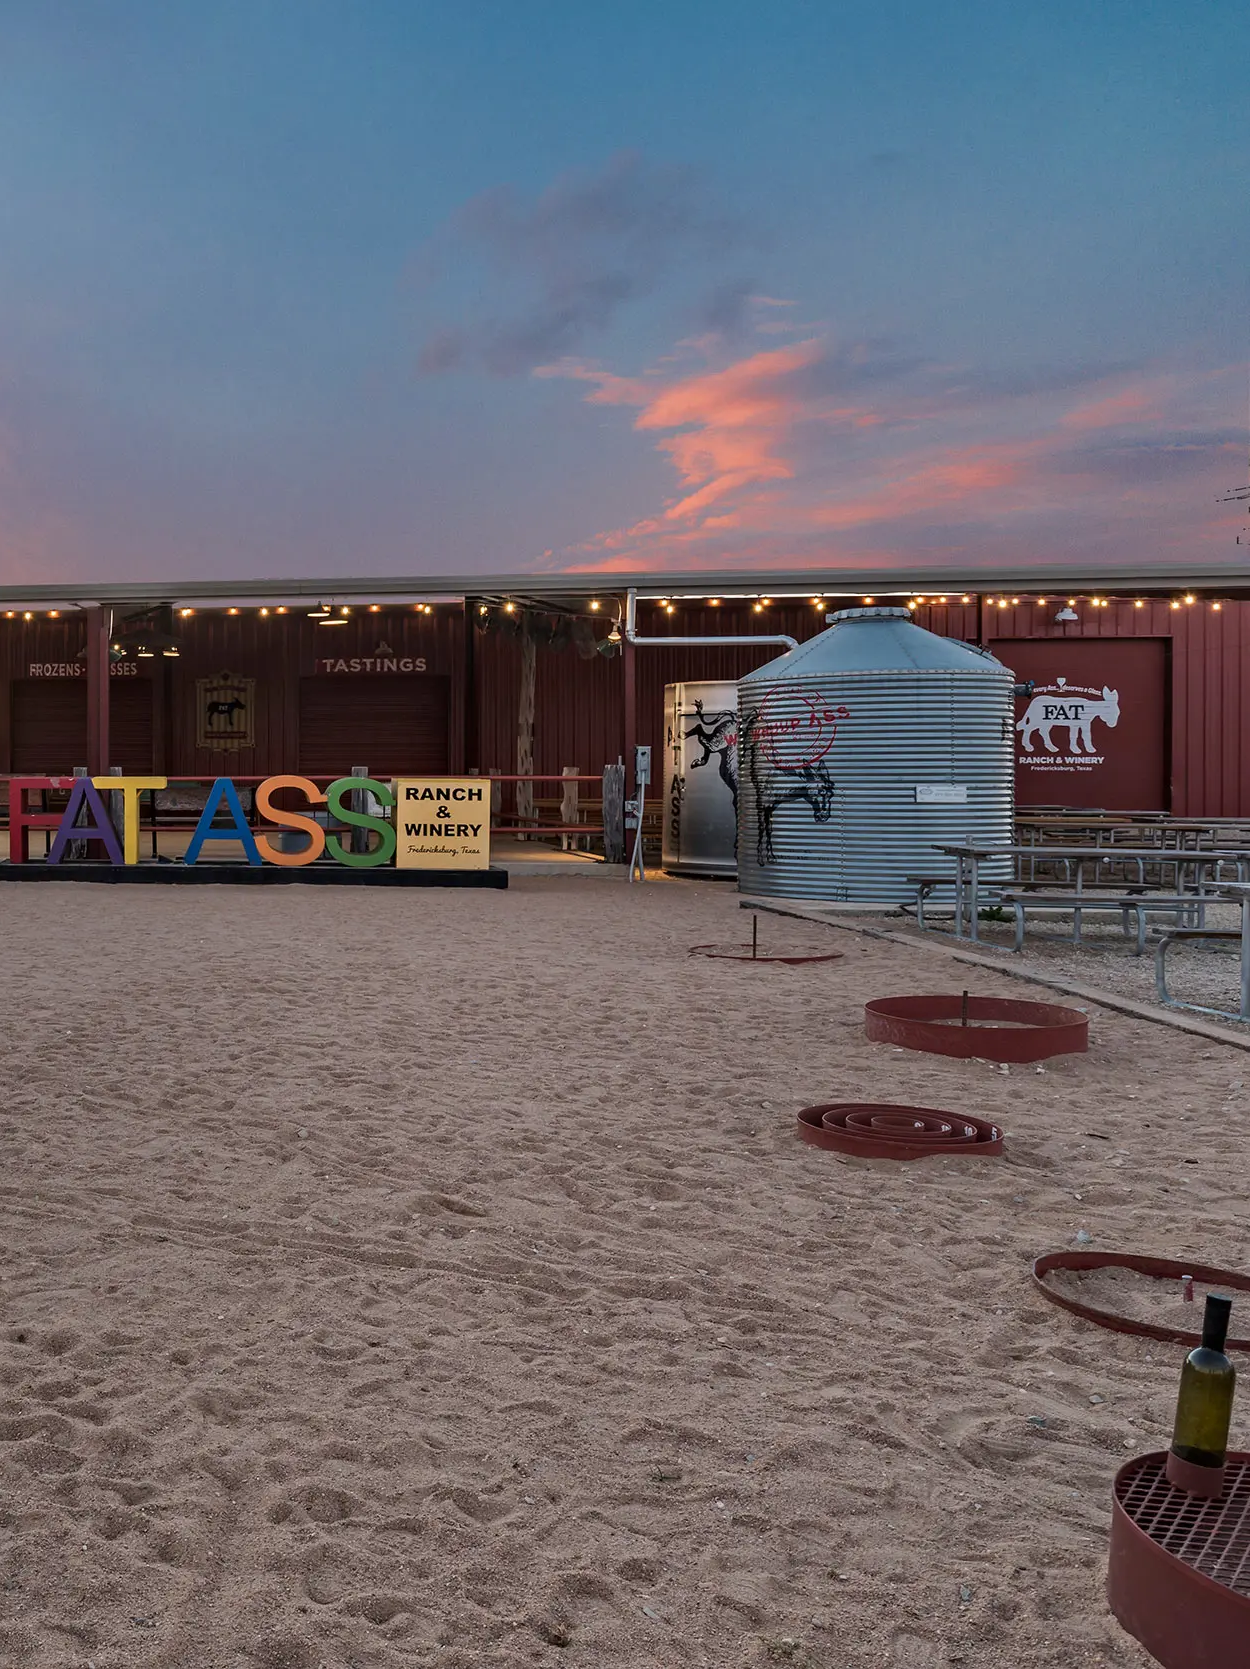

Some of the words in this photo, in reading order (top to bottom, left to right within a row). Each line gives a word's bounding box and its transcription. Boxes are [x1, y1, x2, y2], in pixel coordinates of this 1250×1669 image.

[322, 658, 427, 673] TASTINGS
[808, 706, 850, 729] ASS
[1042, 704, 1084, 720] FAT
[1019, 756, 1054, 764] RANCH
[1055, 756, 1063, 764] &
[1064, 756, 1105, 764] WINERY
[405, 787, 482, 802] RANCH
[436, 805, 452, 819] &
[10, 776, 168, 865] FAT
[183, 775, 396, 867] ASS
[404, 823, 482, 837] WINERY
[407, 845, 459, 857] Fredericksburg,
[460, 846, 481, 854] Texas
